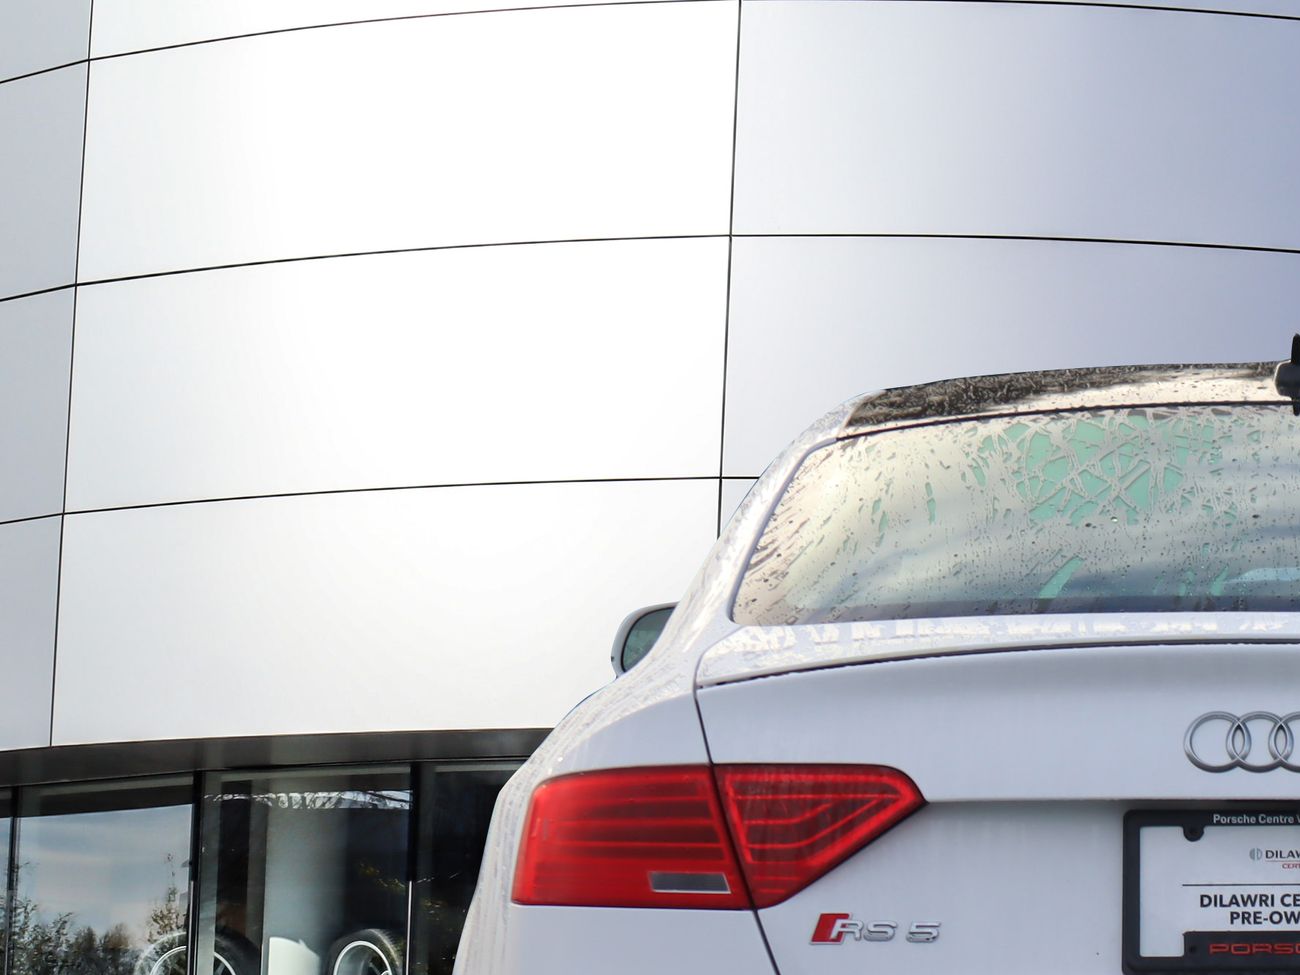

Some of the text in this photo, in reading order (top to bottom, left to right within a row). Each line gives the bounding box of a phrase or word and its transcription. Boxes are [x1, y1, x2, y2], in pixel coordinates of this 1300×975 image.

[1213, 814, 1256, 824] Porsche
[1258, 814, 1294, 824] Centre
[1200, 894, 1275, 908] DILAWRI
[906, 920, 941, 943] 5
